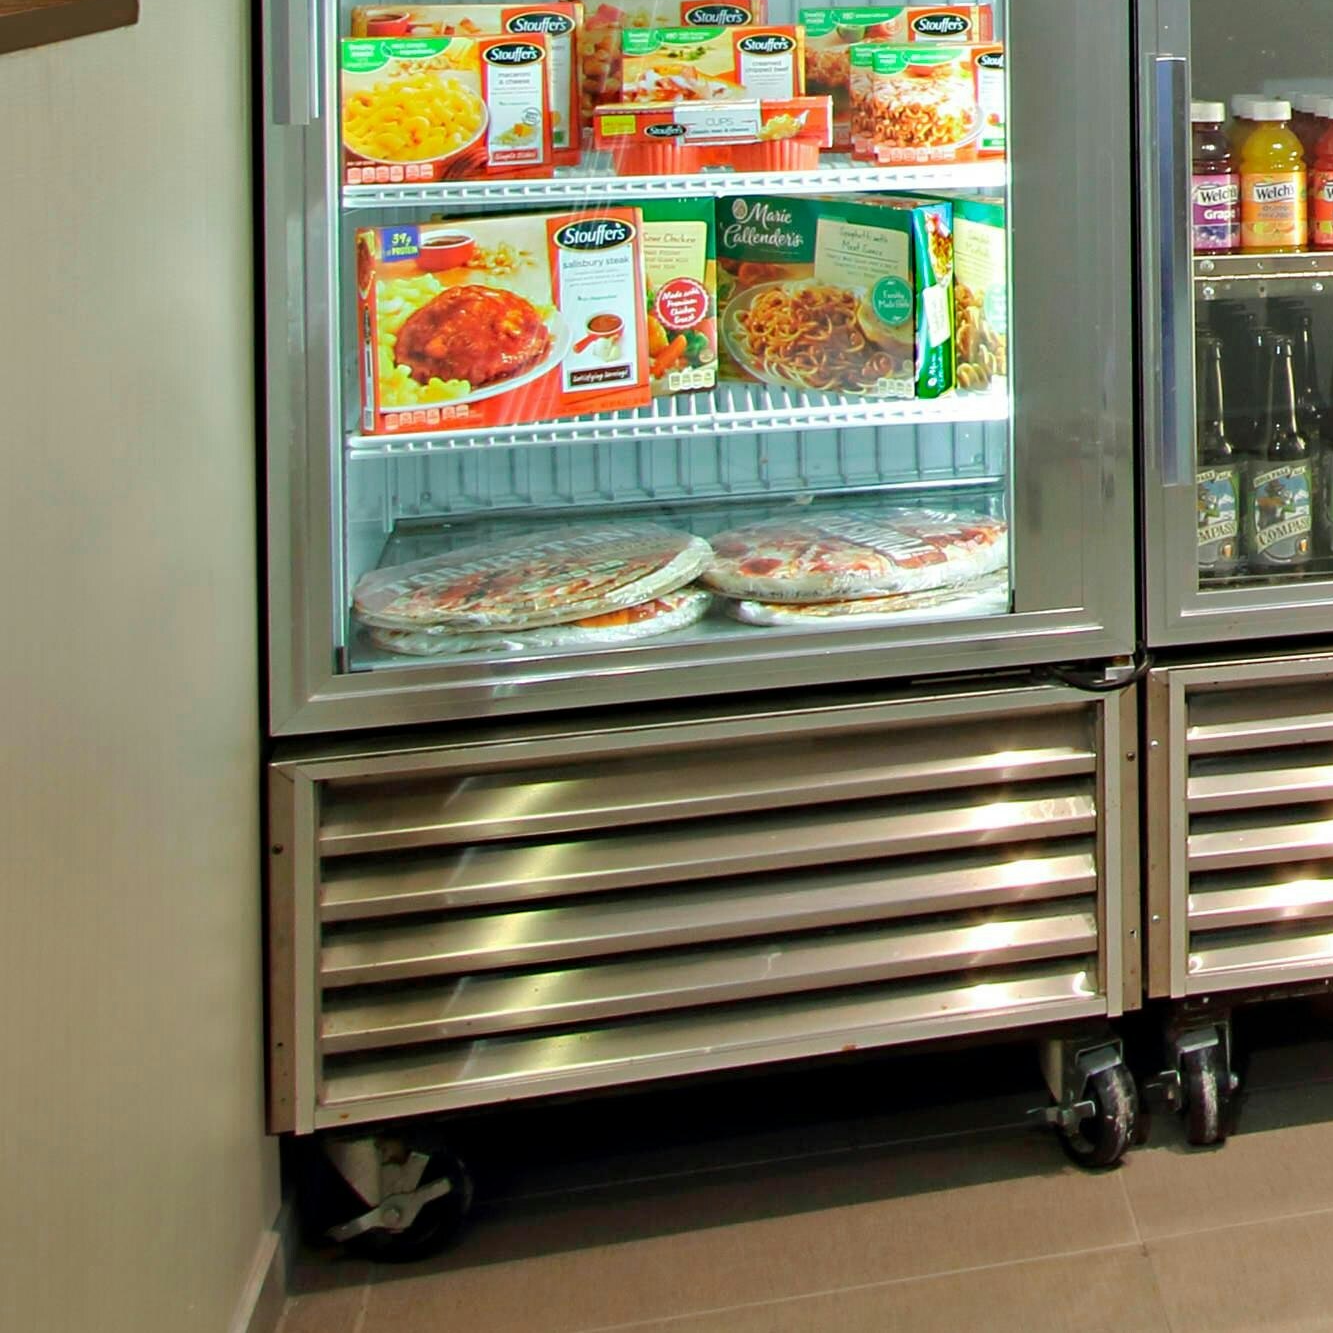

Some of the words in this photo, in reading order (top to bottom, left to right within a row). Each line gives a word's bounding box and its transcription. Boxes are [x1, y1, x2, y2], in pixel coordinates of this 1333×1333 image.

[514, 16, 567, 33] Stouffer's
[690, 9, 744, 25] Stouffer's
[917, 17, 969, 35] Stouffer's
[490, 45, 539, 63] Stouffer's
[744, 37, 791, 53] Stouffer's
[1256, 182, 1295, 201] Welch's
[751, 201, 793, 225] Marie
[563, 223, 627, 244] Stouffer's
[723, 224, 803, 248] Callender's
[563, 257, 602, 269] salisbury
[605, 256, 630, 266] steak
